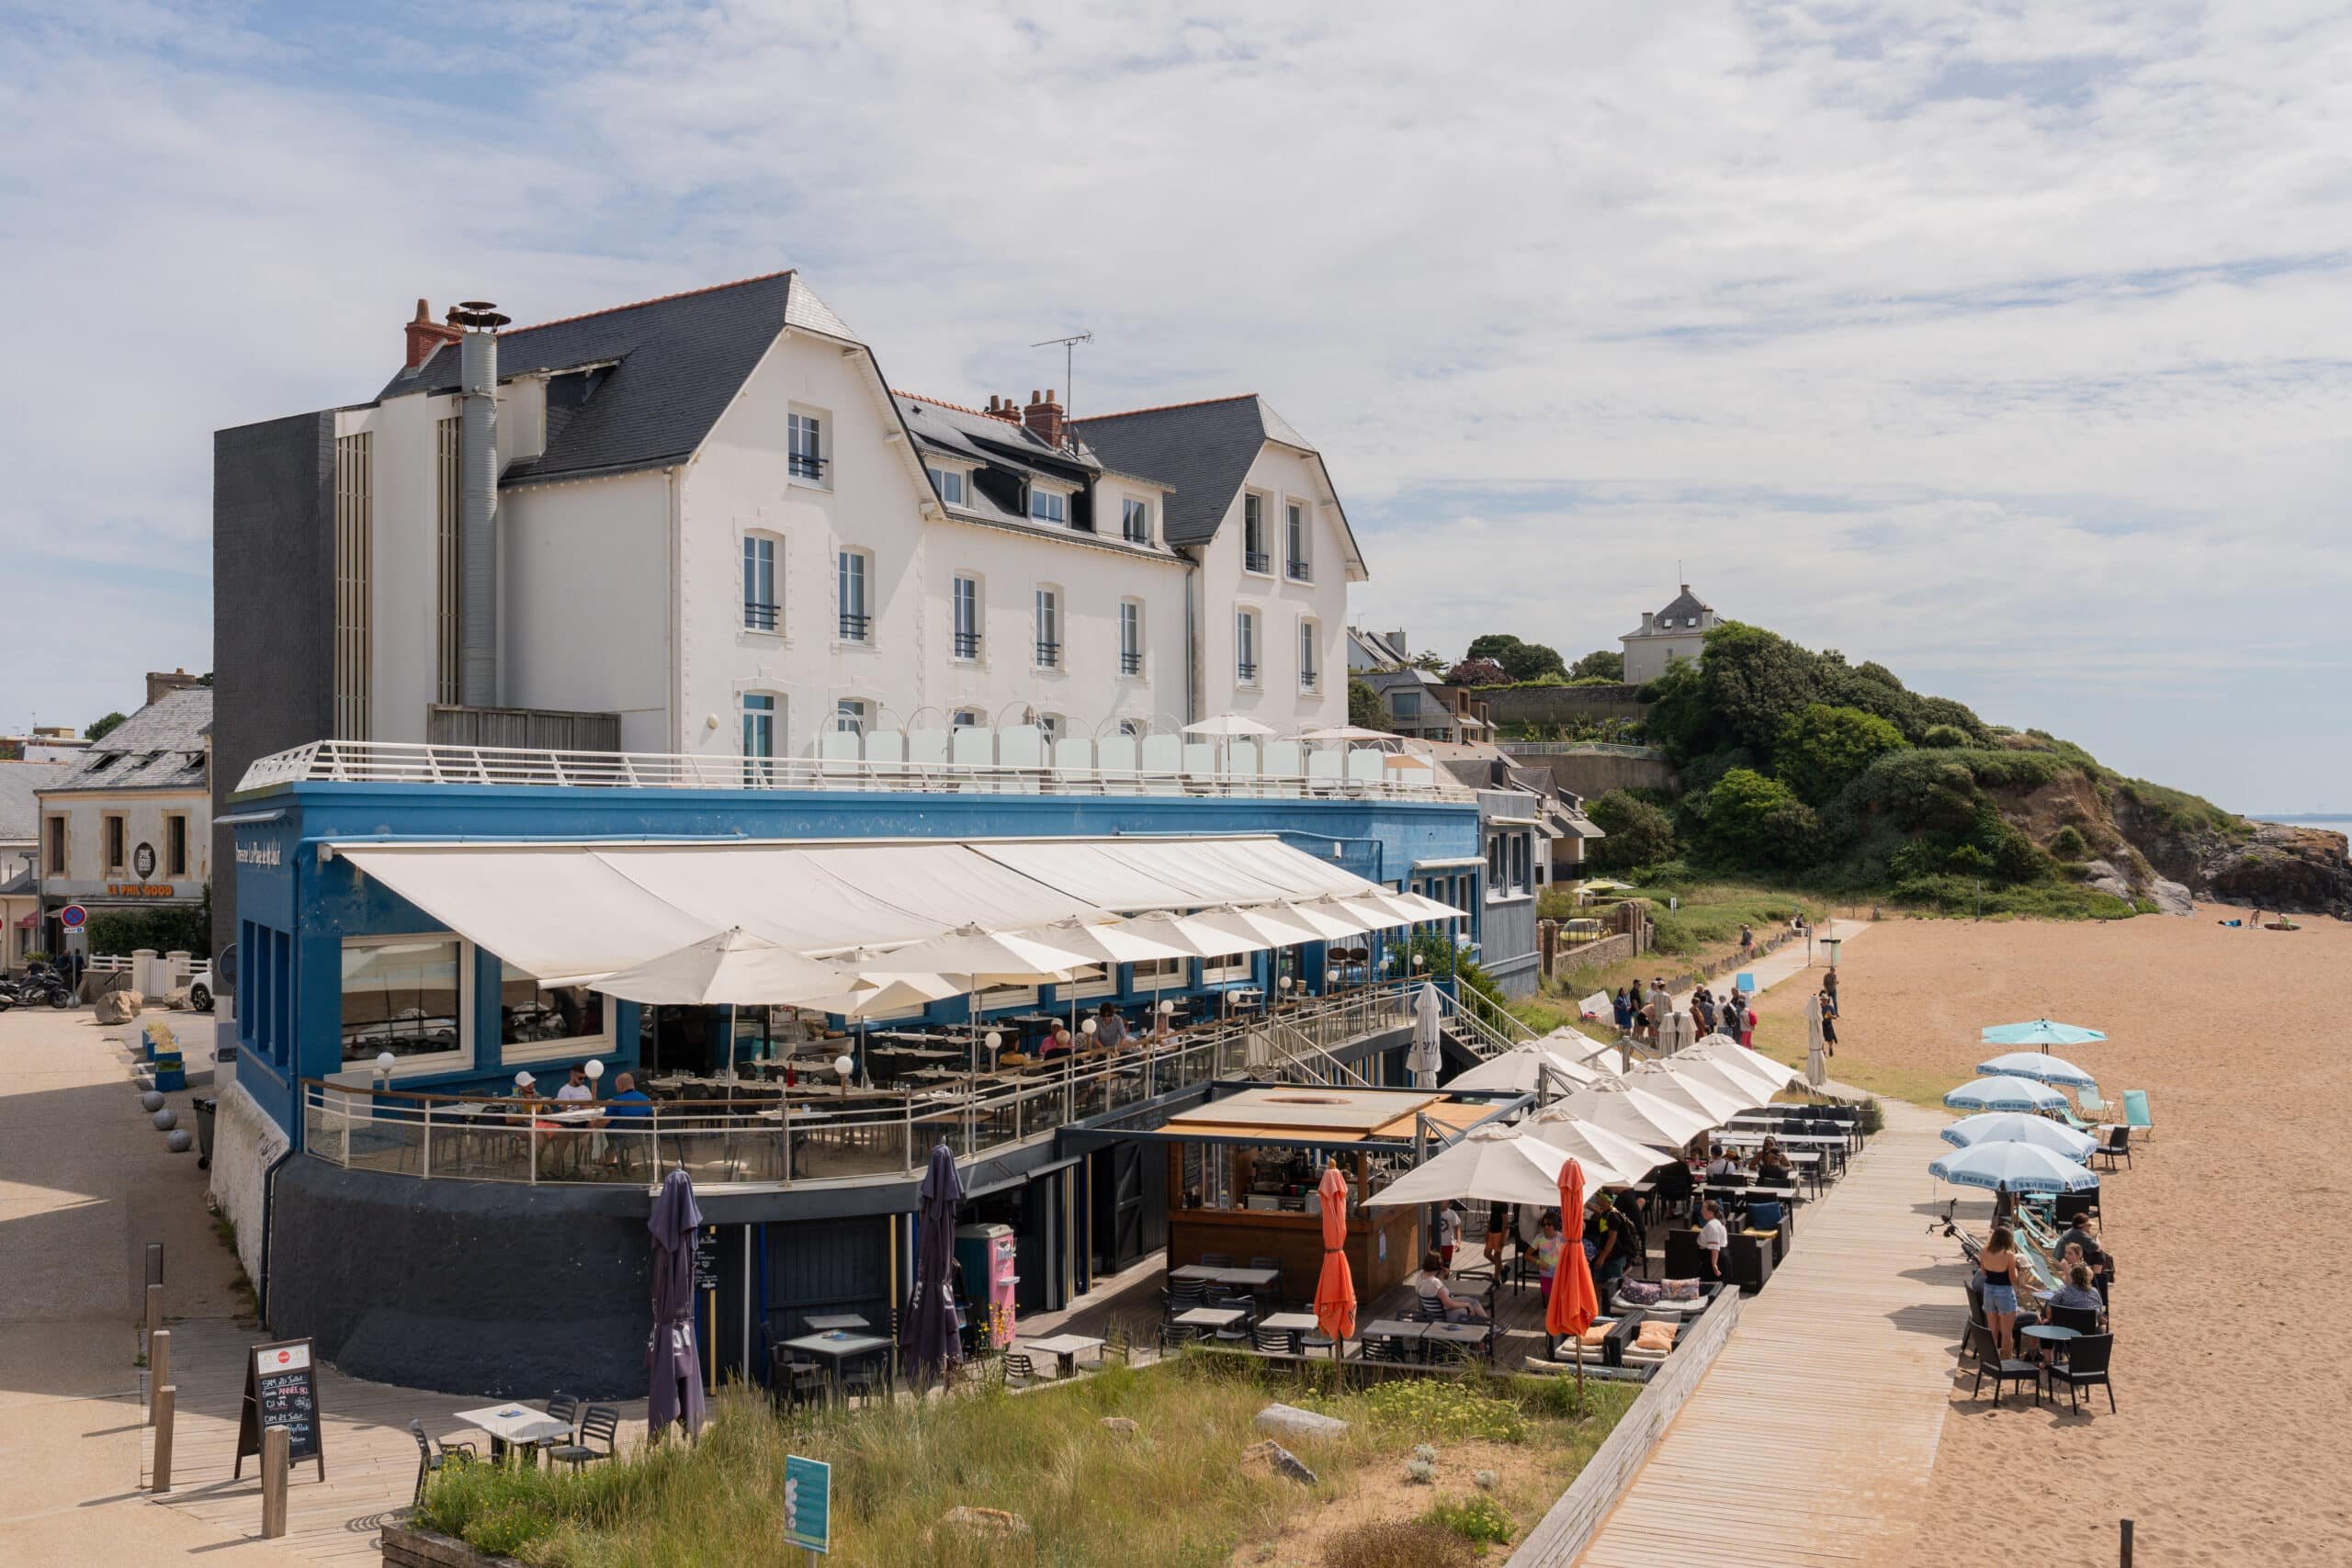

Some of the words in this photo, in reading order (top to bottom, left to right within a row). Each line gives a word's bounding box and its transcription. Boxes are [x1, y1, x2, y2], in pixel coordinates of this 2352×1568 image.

[107, 884, 118, 895] LE
[120, 884, 141, 897] PHIL
[144, 885, 172, 897] GOOD
[262, 1379, 277, 1387] SAM
